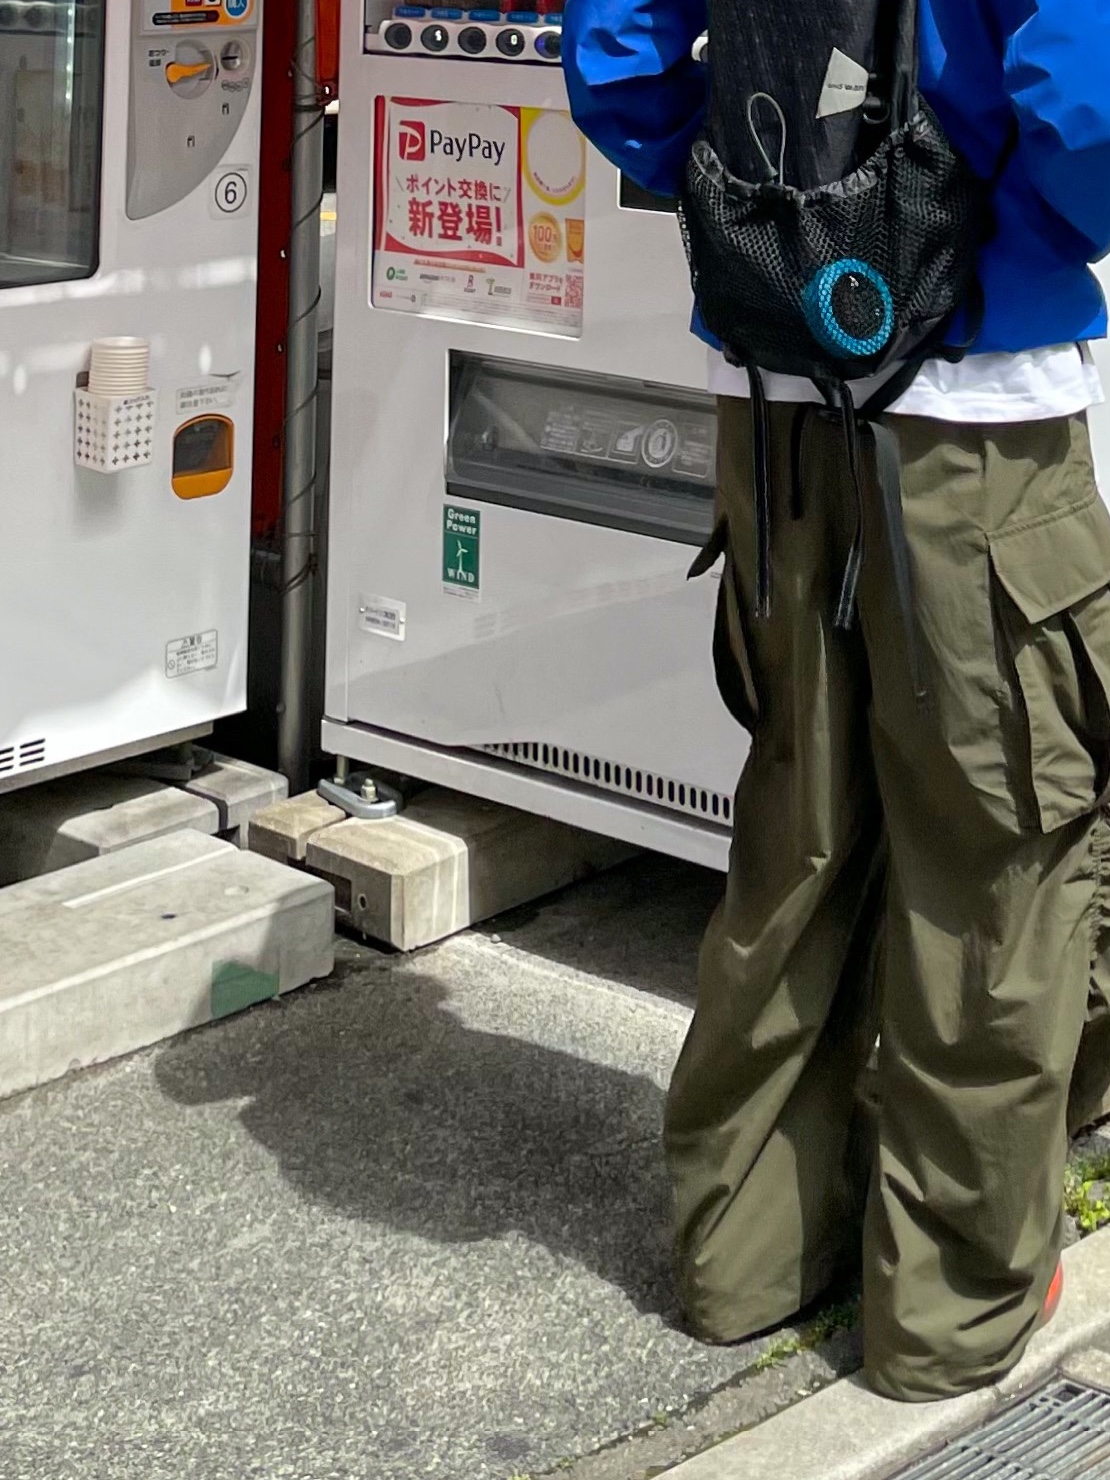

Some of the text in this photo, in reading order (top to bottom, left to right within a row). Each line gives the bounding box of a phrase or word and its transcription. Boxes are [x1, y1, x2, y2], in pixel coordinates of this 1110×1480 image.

[430, 129, 506, 166] PayPay
[406, 174, 502, 202] ポイント交換に
[408, 197, 502, 247] 新登場!
[447, 508, 476, 524] Green
[446, 520, 477, 535] Power
[447, 567, 475, 583] WIND
